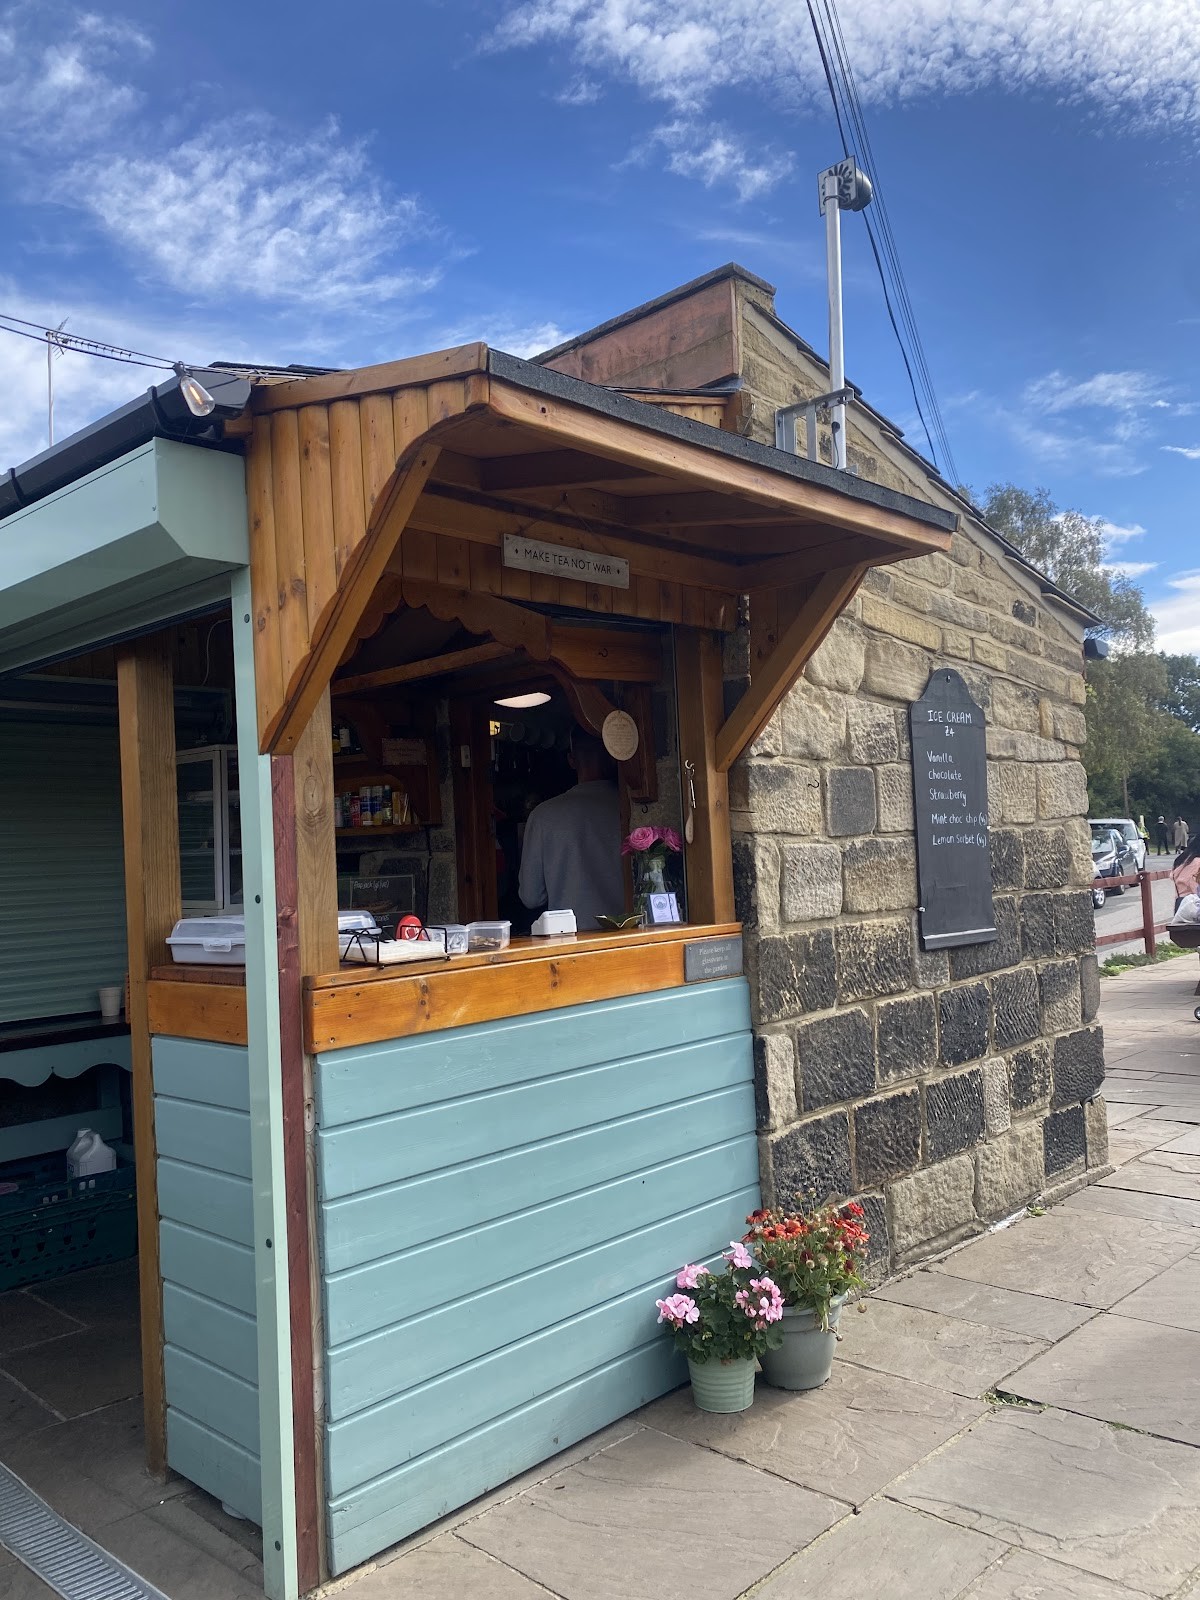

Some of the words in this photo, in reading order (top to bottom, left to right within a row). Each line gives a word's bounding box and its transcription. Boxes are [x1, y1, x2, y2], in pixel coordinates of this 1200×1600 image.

[524, 548, 550, 563] MAKE
[552, 554, 570, 566] TEA
[571, 557, 592, 570] NOT
[593, 562, 612, 575] WAR
[927, 709, 944, 723] ICE
[946, 710, 973, 724] CREAM
[926, 750, 954, 764] Vanilla
[929, 787, 967, 808] Strawberry
[931, 813, 948, 825] Mint
[932, 834, 955, 846] Lemon
